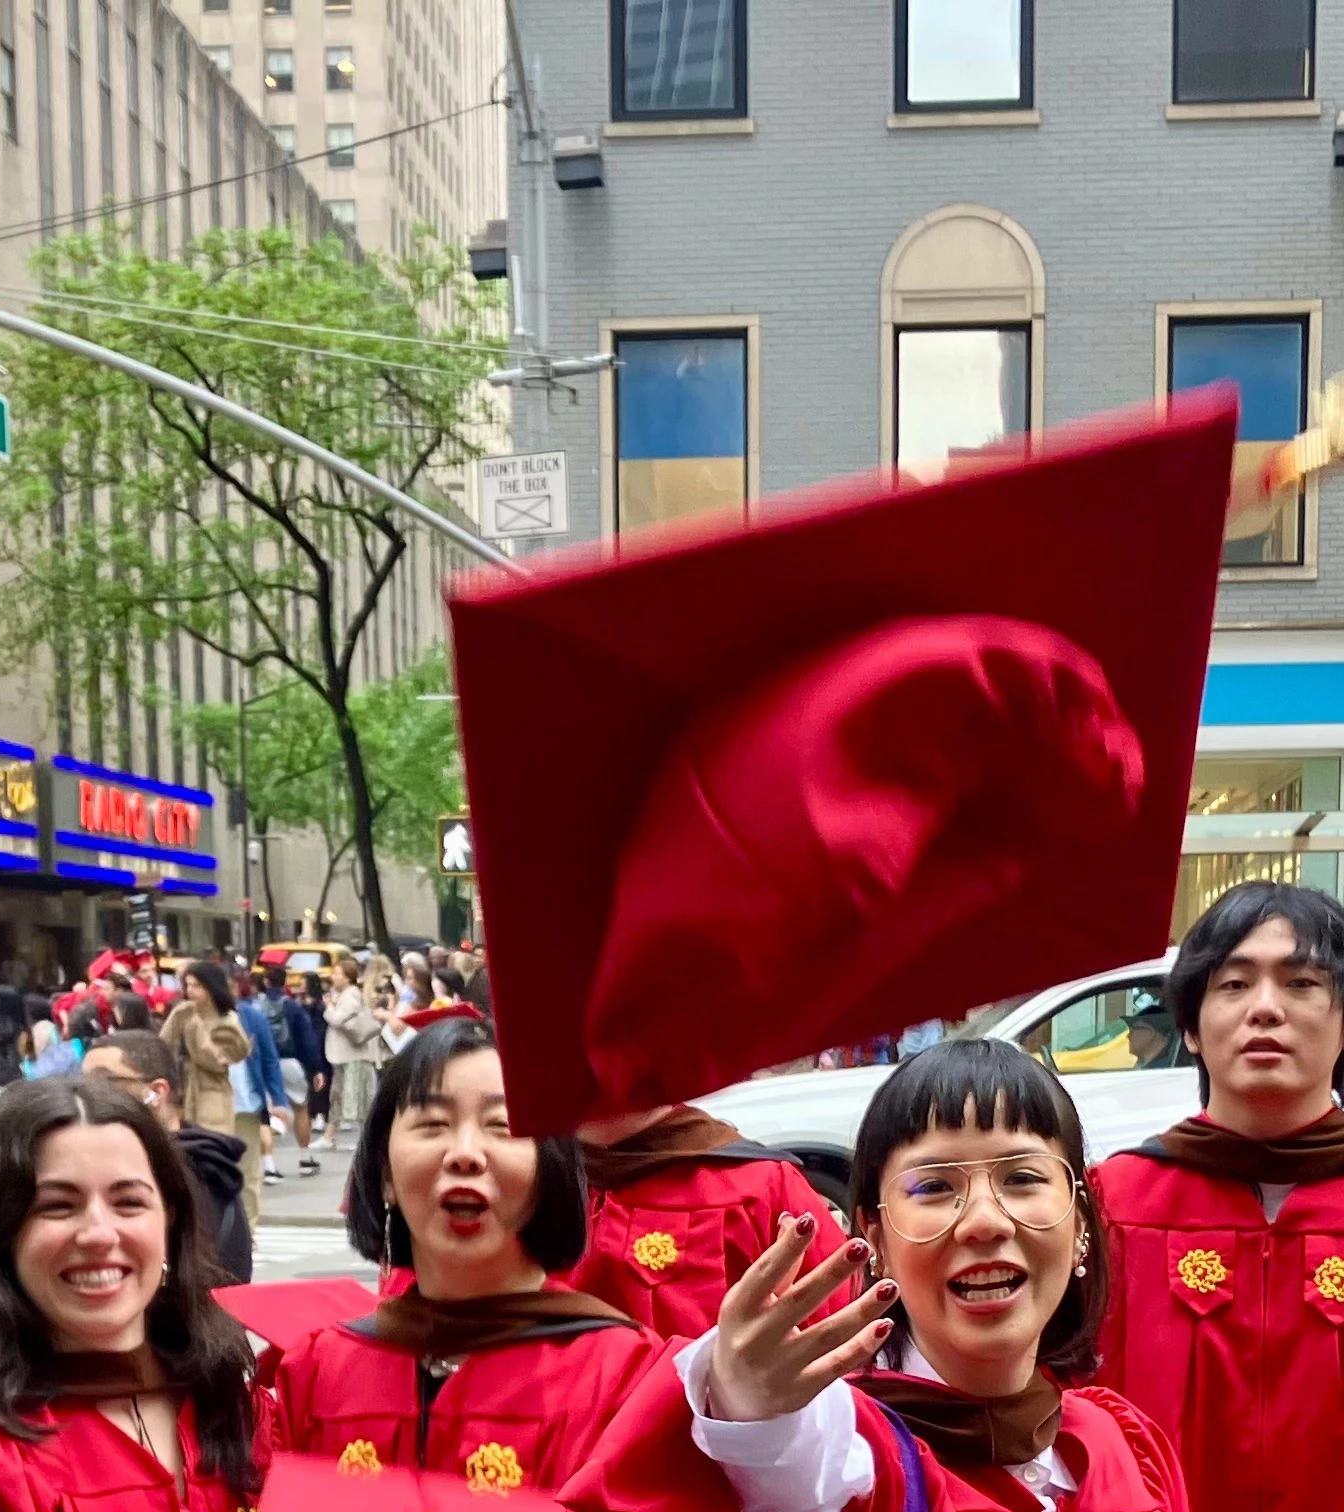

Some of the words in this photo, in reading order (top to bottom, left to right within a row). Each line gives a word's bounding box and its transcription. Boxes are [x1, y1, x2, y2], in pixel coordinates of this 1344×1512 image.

[483, 461, 517, 478] DON'T
[521, 456, 560, 474] BLOCK
[499, 479, 519, 494] THE
[524, 477, 547, 493] BOX
[79, 779, 148, 841] RADIO
[152, 798, 201, 849] CITY
